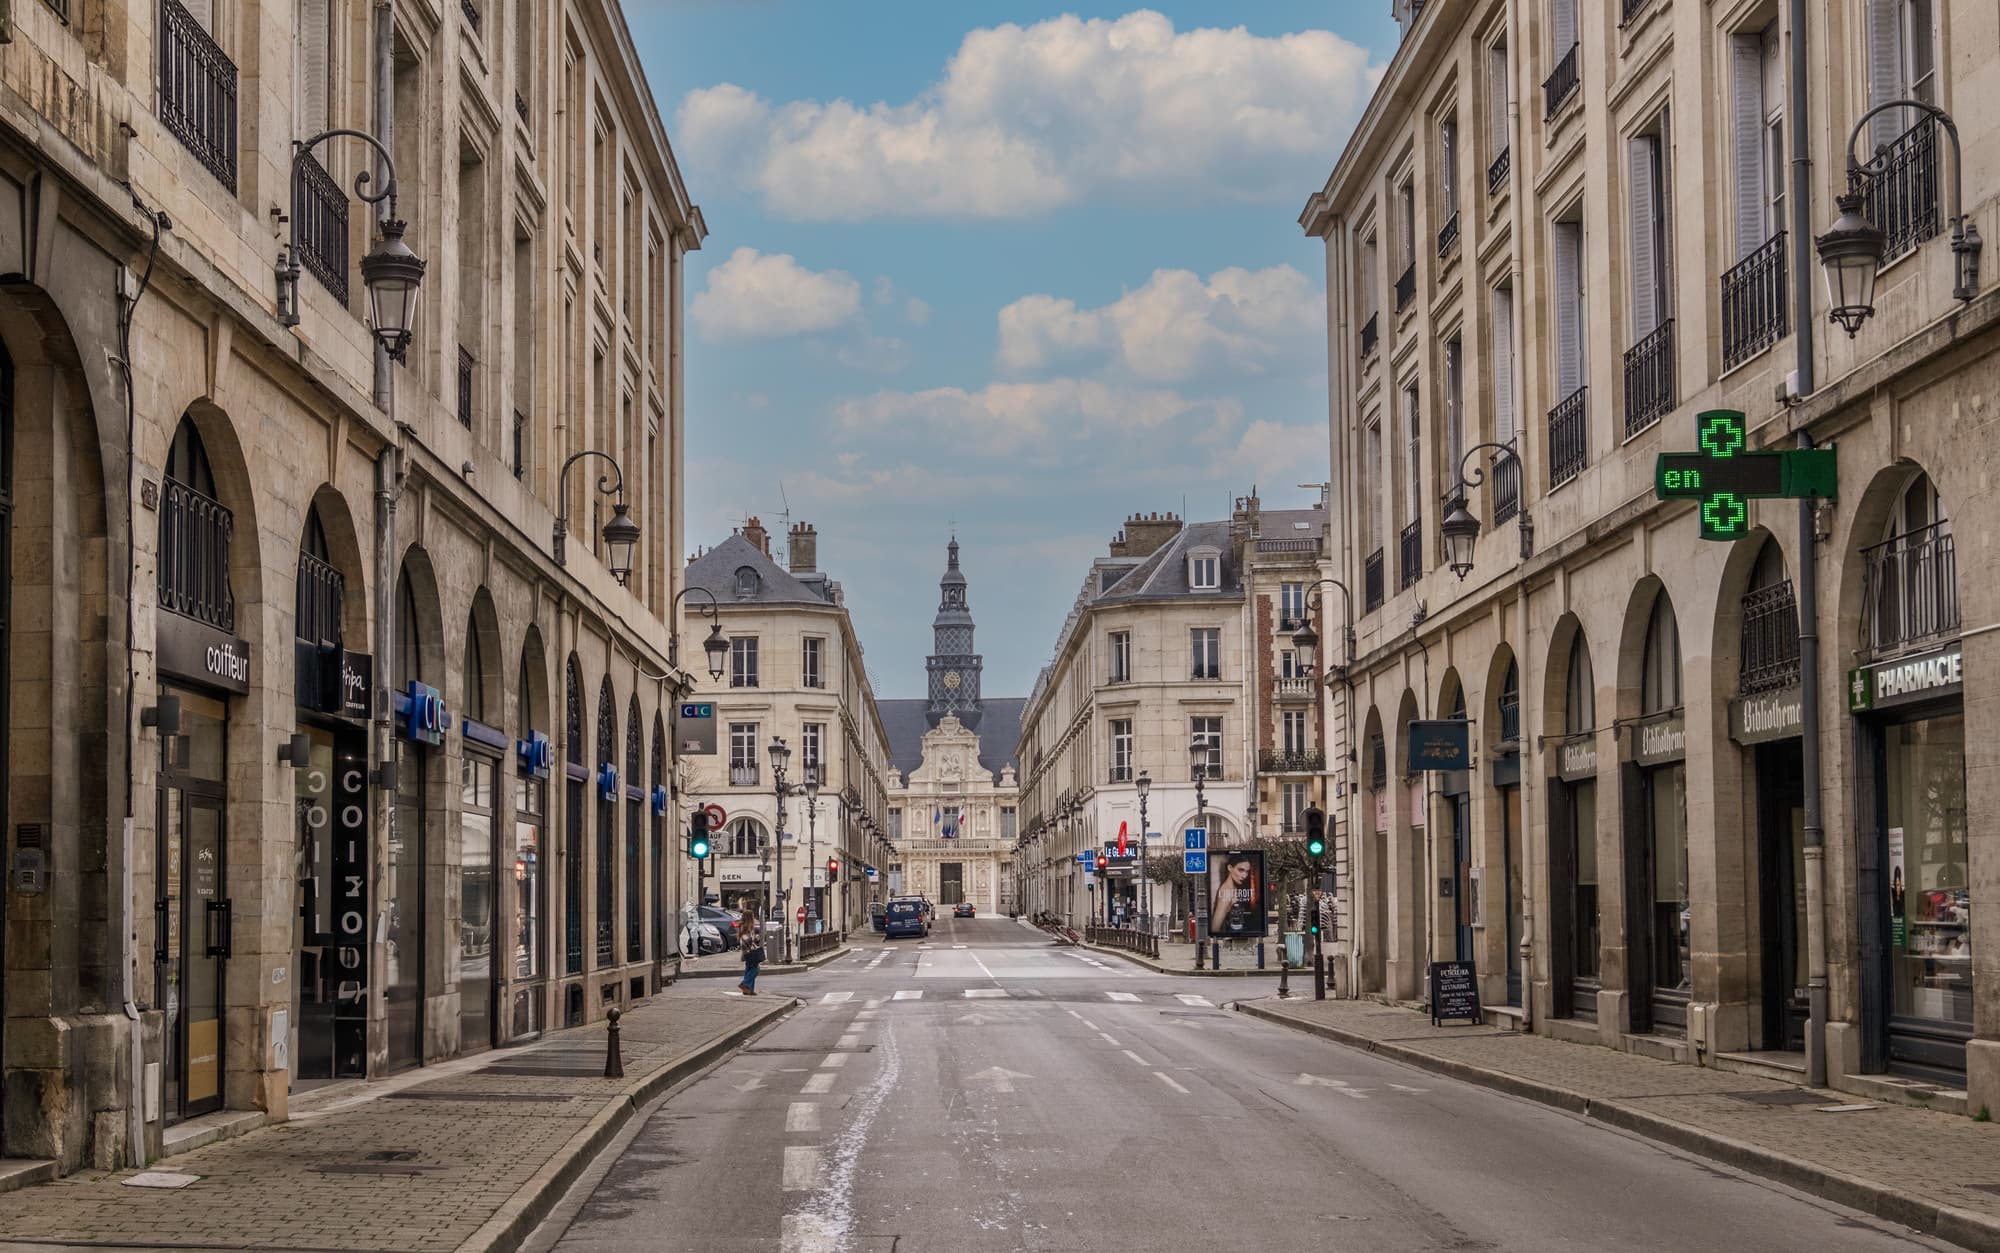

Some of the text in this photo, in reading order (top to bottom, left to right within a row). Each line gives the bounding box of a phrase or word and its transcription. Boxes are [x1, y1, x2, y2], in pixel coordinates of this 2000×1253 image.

[1665, 470, 1699, 488] en
[207, 643, 248, 682] coiffeur
[1877, 653, 1962, 698] PHARMACIE
[425, 695, 445, 733] CIC
[684, 705, 710, 716] CIC
